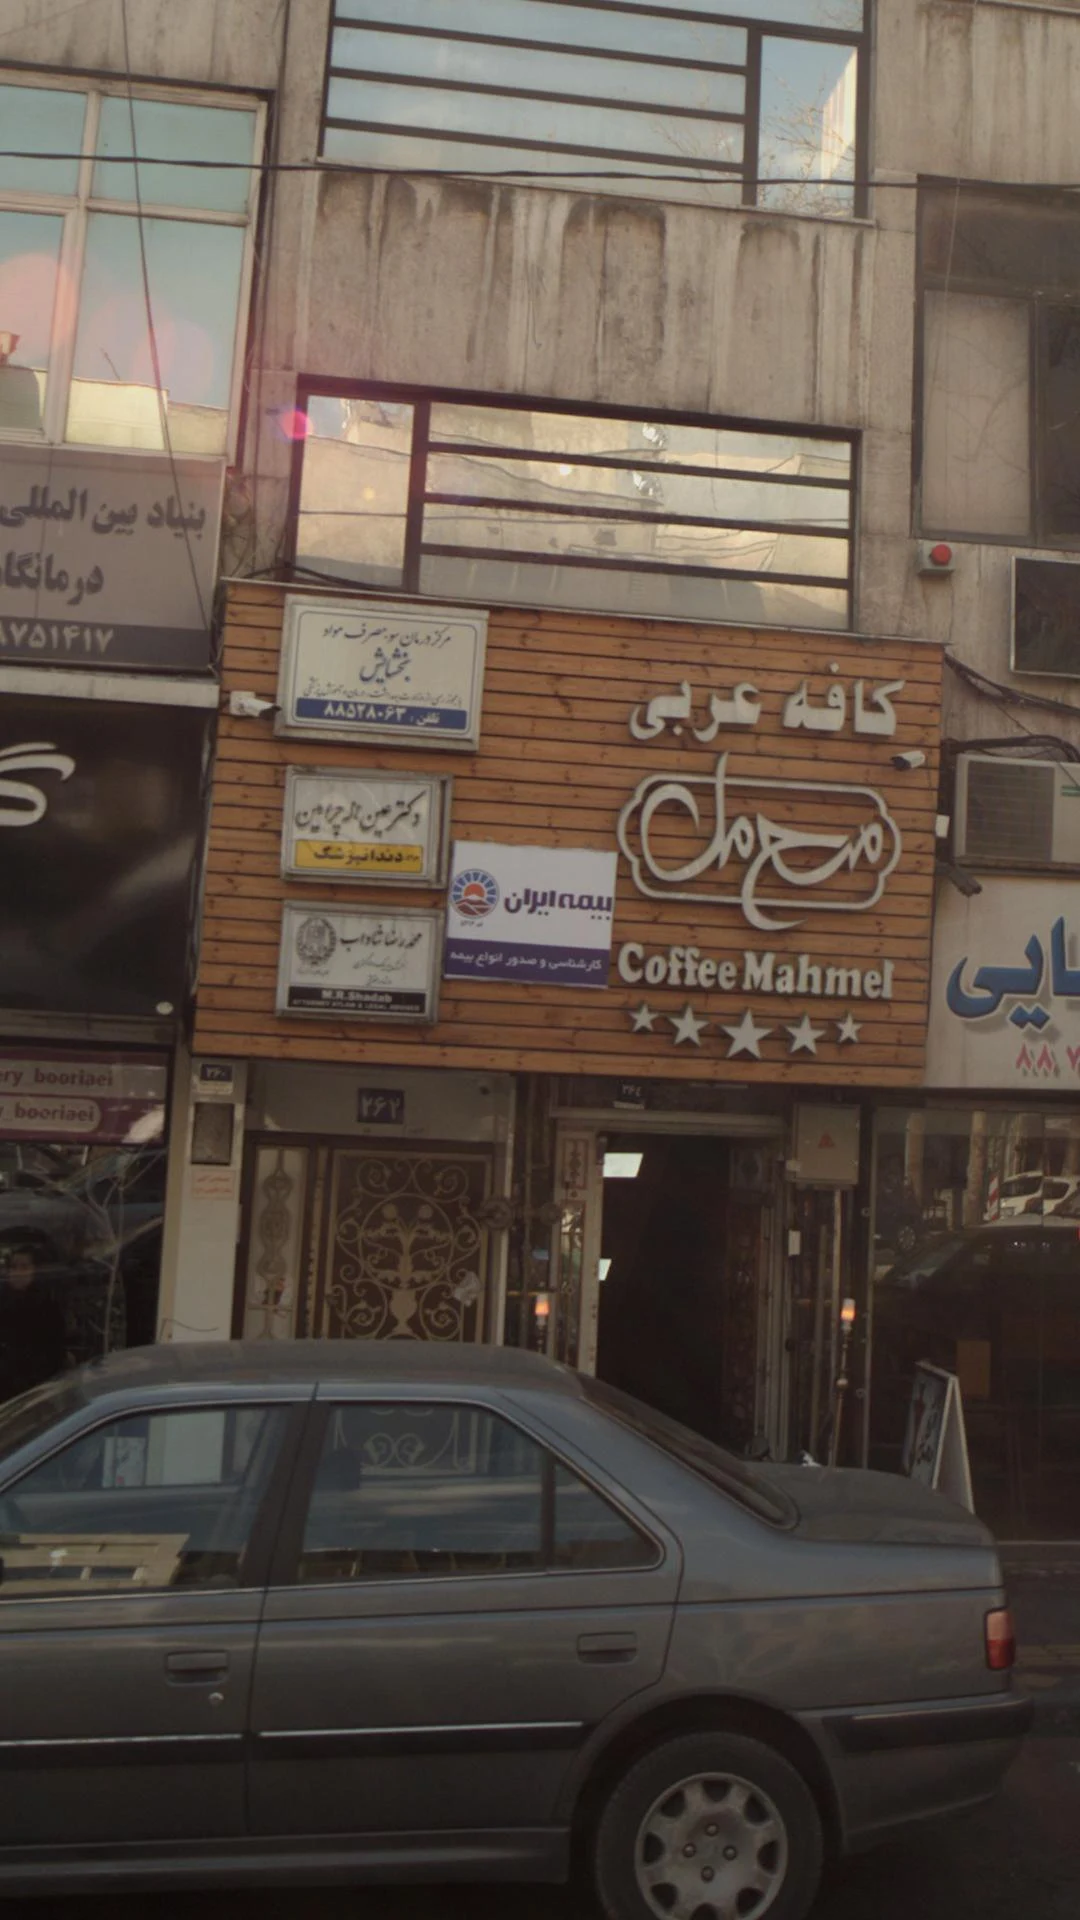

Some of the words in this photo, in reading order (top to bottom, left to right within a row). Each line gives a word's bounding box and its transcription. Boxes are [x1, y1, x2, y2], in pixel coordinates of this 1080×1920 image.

[0, 484, 89, 527] المللی
[91, 503, 138, 535] بین
[146, 494, 206, 540] بنیاد
[0, 550, 104, 606] درمانگا
[323, 624, 343, 638] مواد
[344, 623, 388, 644] مصرف
[399, 632, 431, 647] درمان
[427, 625, 452, 648] مرکز
[359, 646, 412, 684] بخشایش
[323, 701, 407, 721] ۸۸۵۲۸۰۶۳
[629, 680, 762, 743] عربی
[782, 661, 906, 736] کافه
[386, 790, 426, 832] دکتر
[640, 752, 884, 931] محمل
[504, 888, 556, 917] ایران
[558, 893, 613, 921] بیمه
[450, 950, 475, 963] بیمه
[475, 951, 504, 967] انواع
[505, 955, 538, 968] صدور
[548, 957, 602, 972] کارشناسی
[617, 941, 737, 989] Coffee
[743, 950, 895, 999] Mahmel
